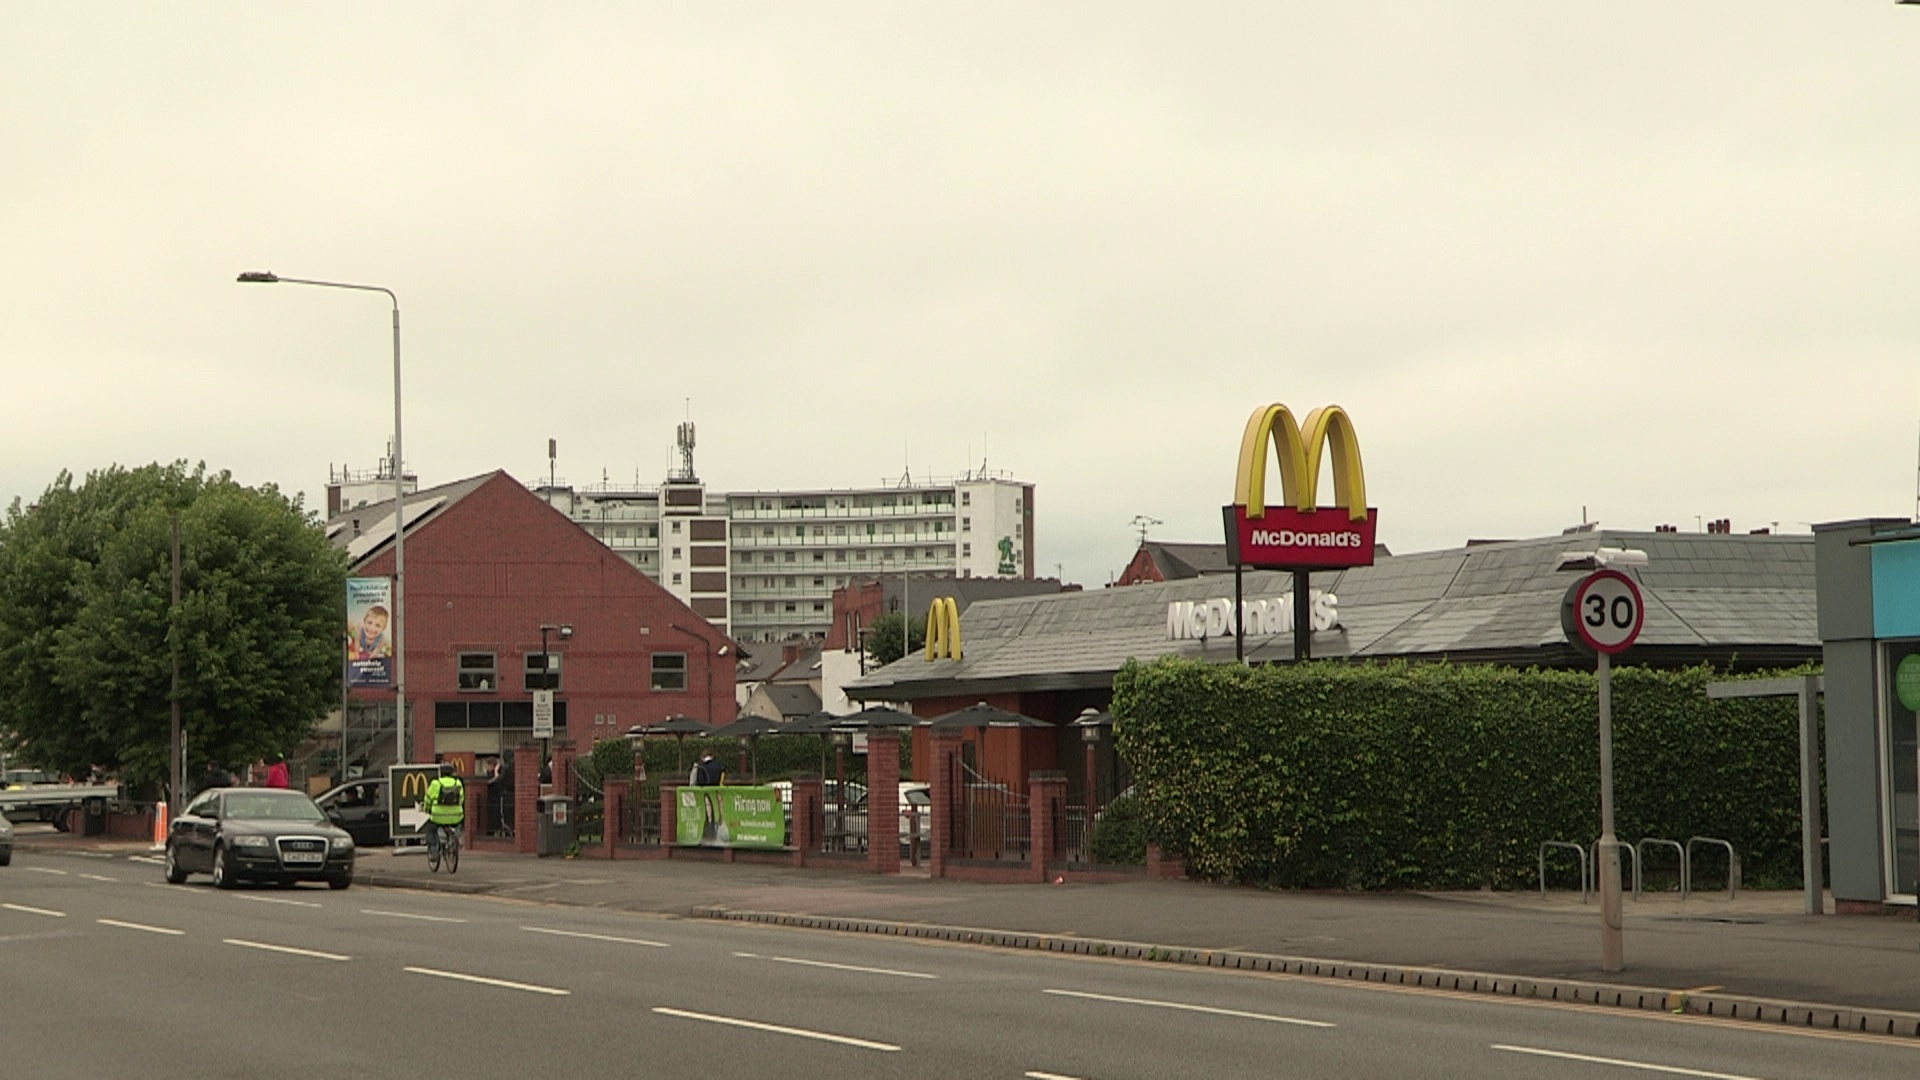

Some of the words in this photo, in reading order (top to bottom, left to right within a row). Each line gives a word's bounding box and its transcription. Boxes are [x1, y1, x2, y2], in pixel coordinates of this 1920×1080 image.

[1251, 529, 1362, 547] McDonald's
[1167, 588, 1338, 640] McDonal's
[1585, 593, 1633, 629] 30
[734, 794, 756, 816] Hiring
[757, 799, 771, 813] now
